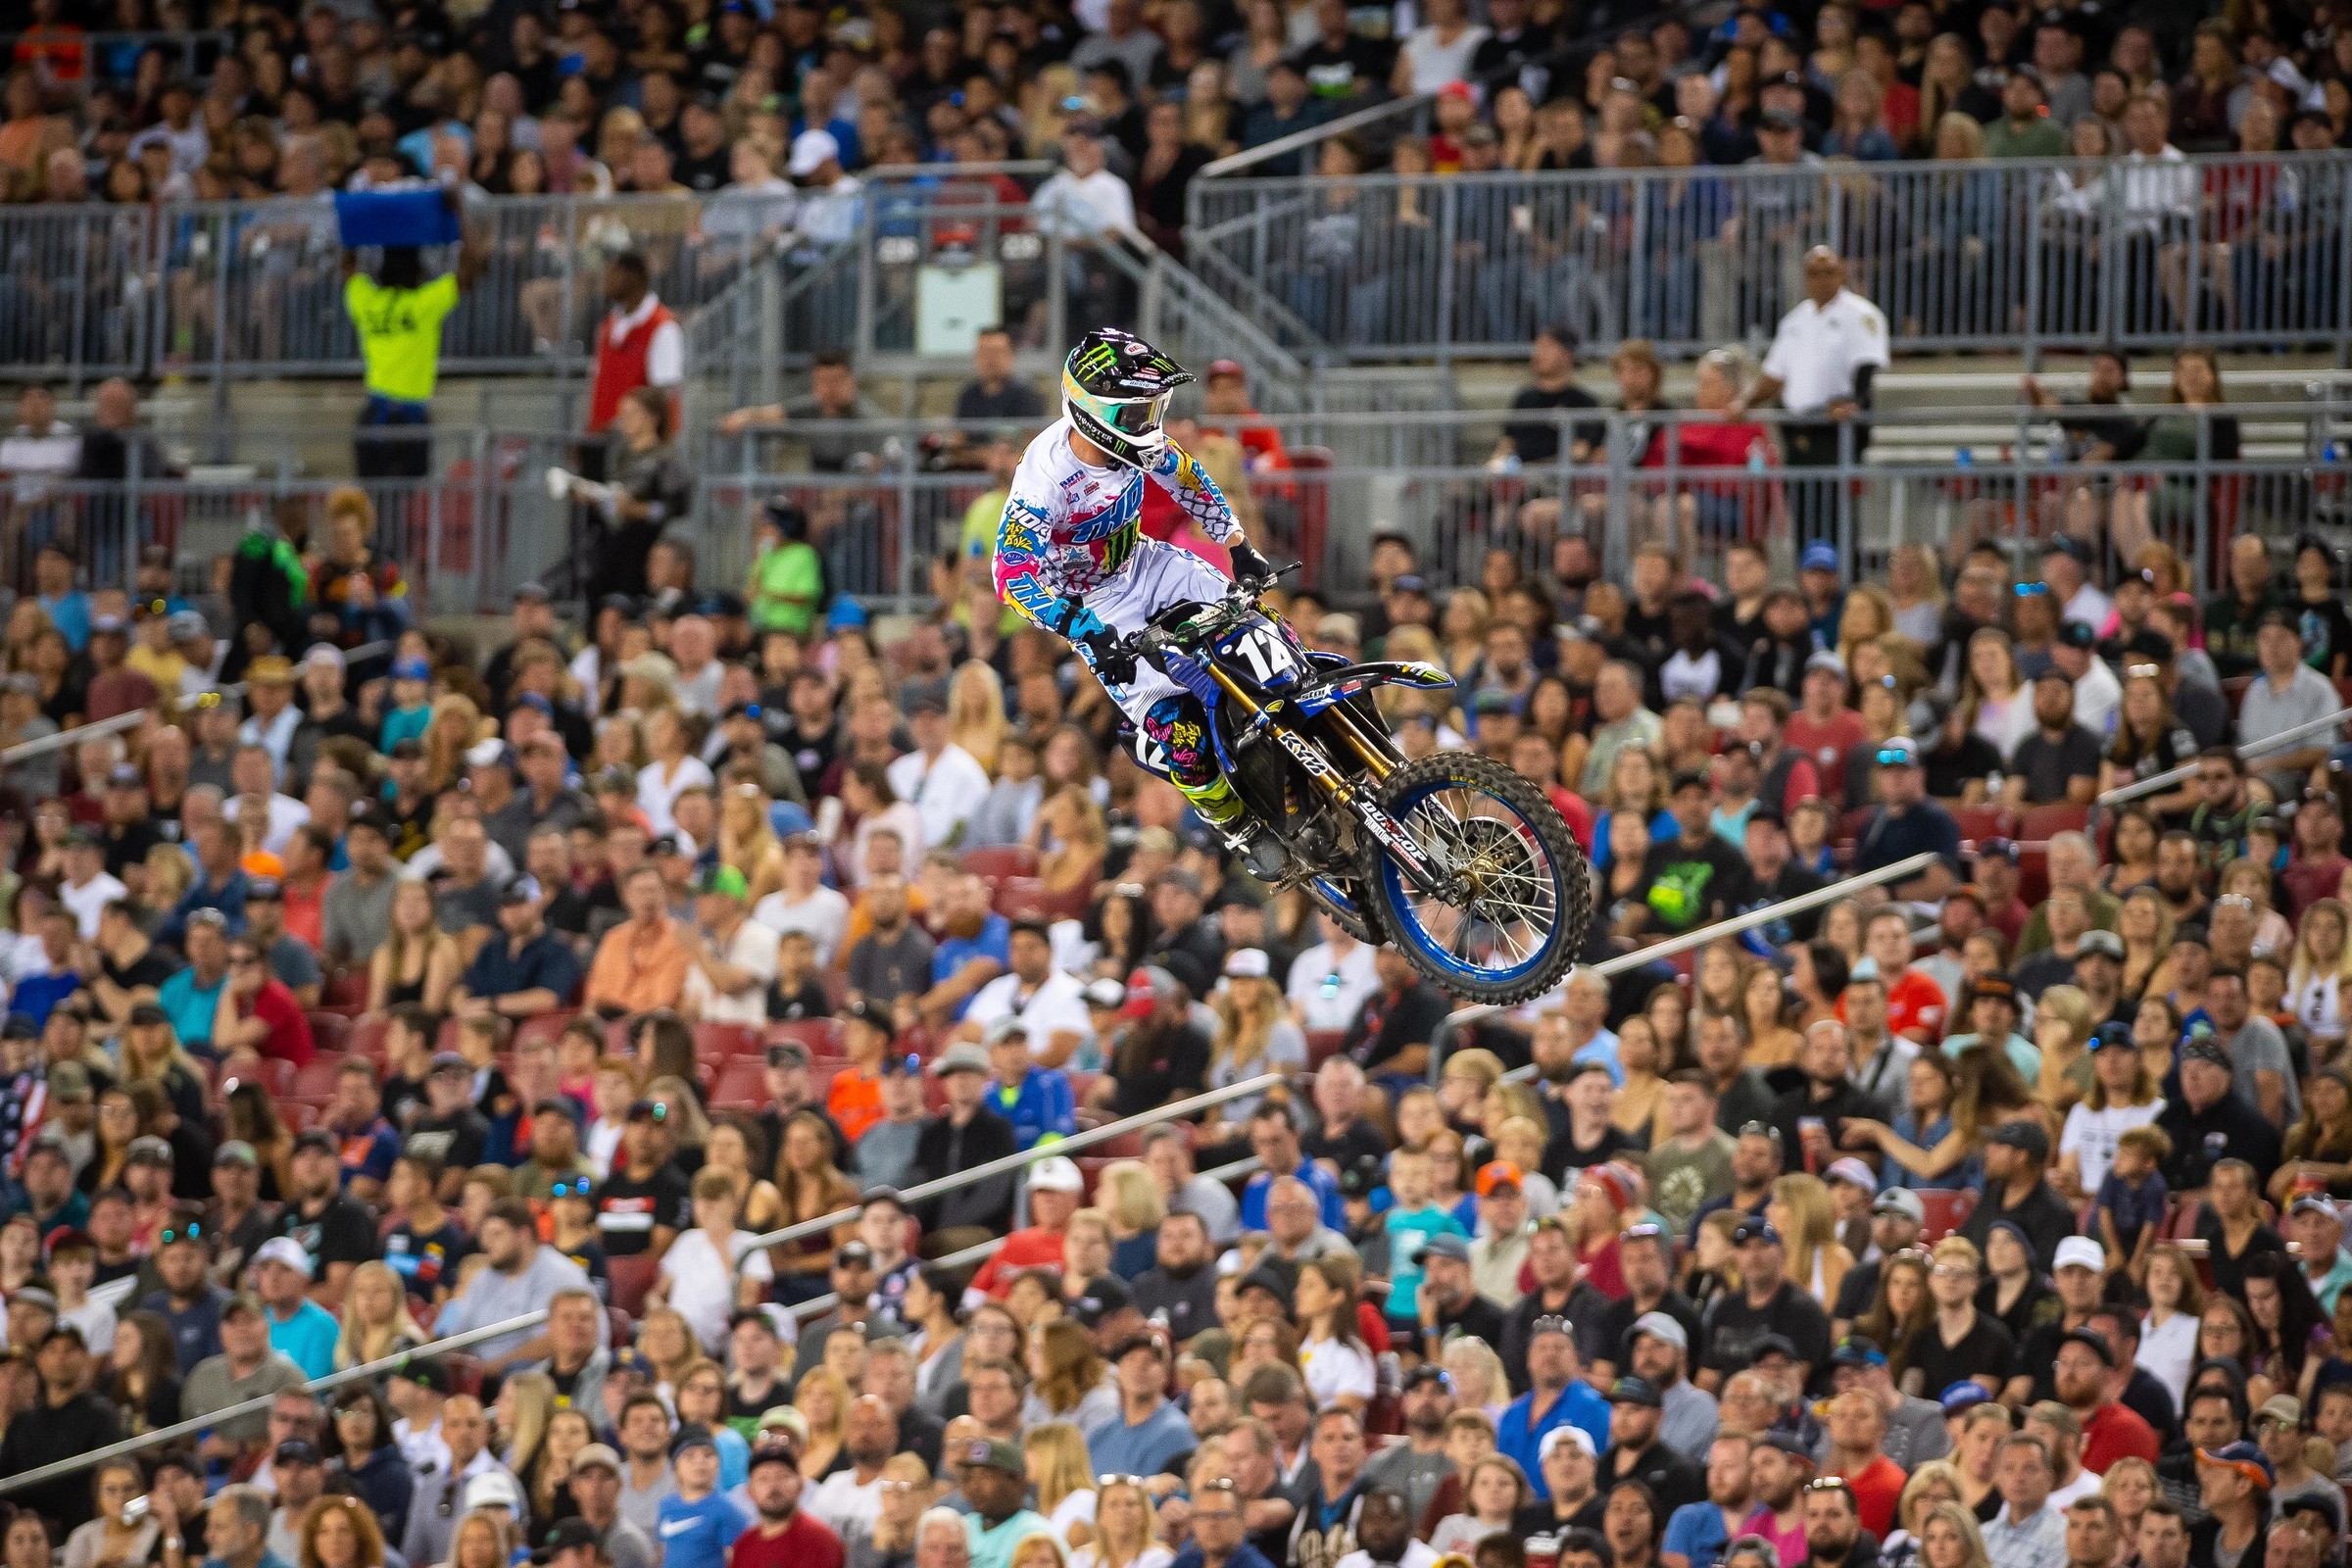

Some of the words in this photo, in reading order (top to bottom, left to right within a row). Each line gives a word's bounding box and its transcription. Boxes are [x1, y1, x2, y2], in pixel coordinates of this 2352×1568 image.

[1075, 412, 1112, 444] MONSTER
[1069, 471, 1145, 544] THO
[1278, 730, 1328, 776] KYB
[1363, 816, 1393, 847] YAMALUBE
